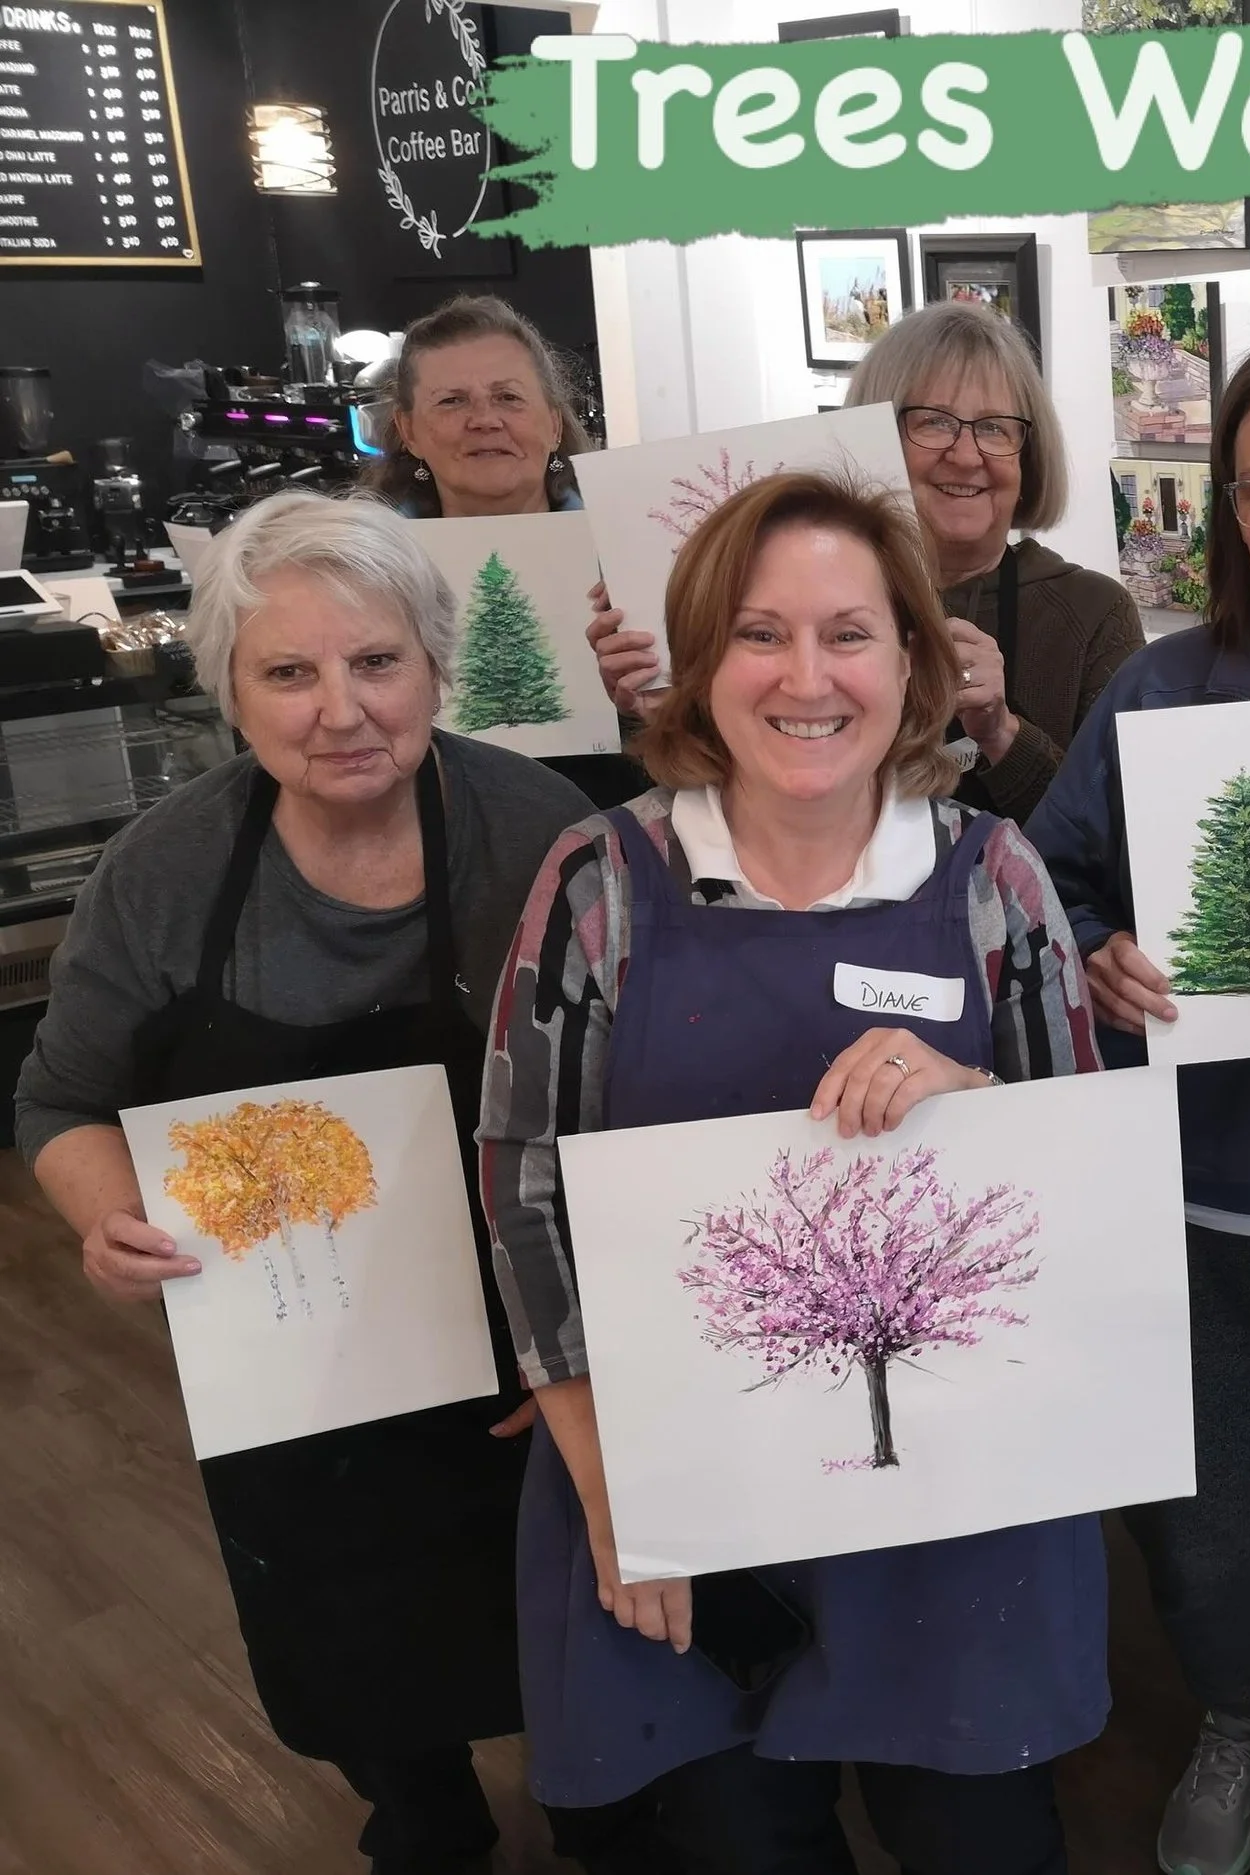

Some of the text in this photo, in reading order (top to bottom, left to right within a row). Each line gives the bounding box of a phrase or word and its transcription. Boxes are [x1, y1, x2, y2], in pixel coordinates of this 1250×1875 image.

[379, 82, 430, 116] Parris
[435, 79, 449, 109] &
[27, 151, 56, 162] LATTE
[388, 129, 481, 163] Coffee Bar
[44, 173, 73, 185] LATTE
[860, 981, 930, 1012] DIANE
